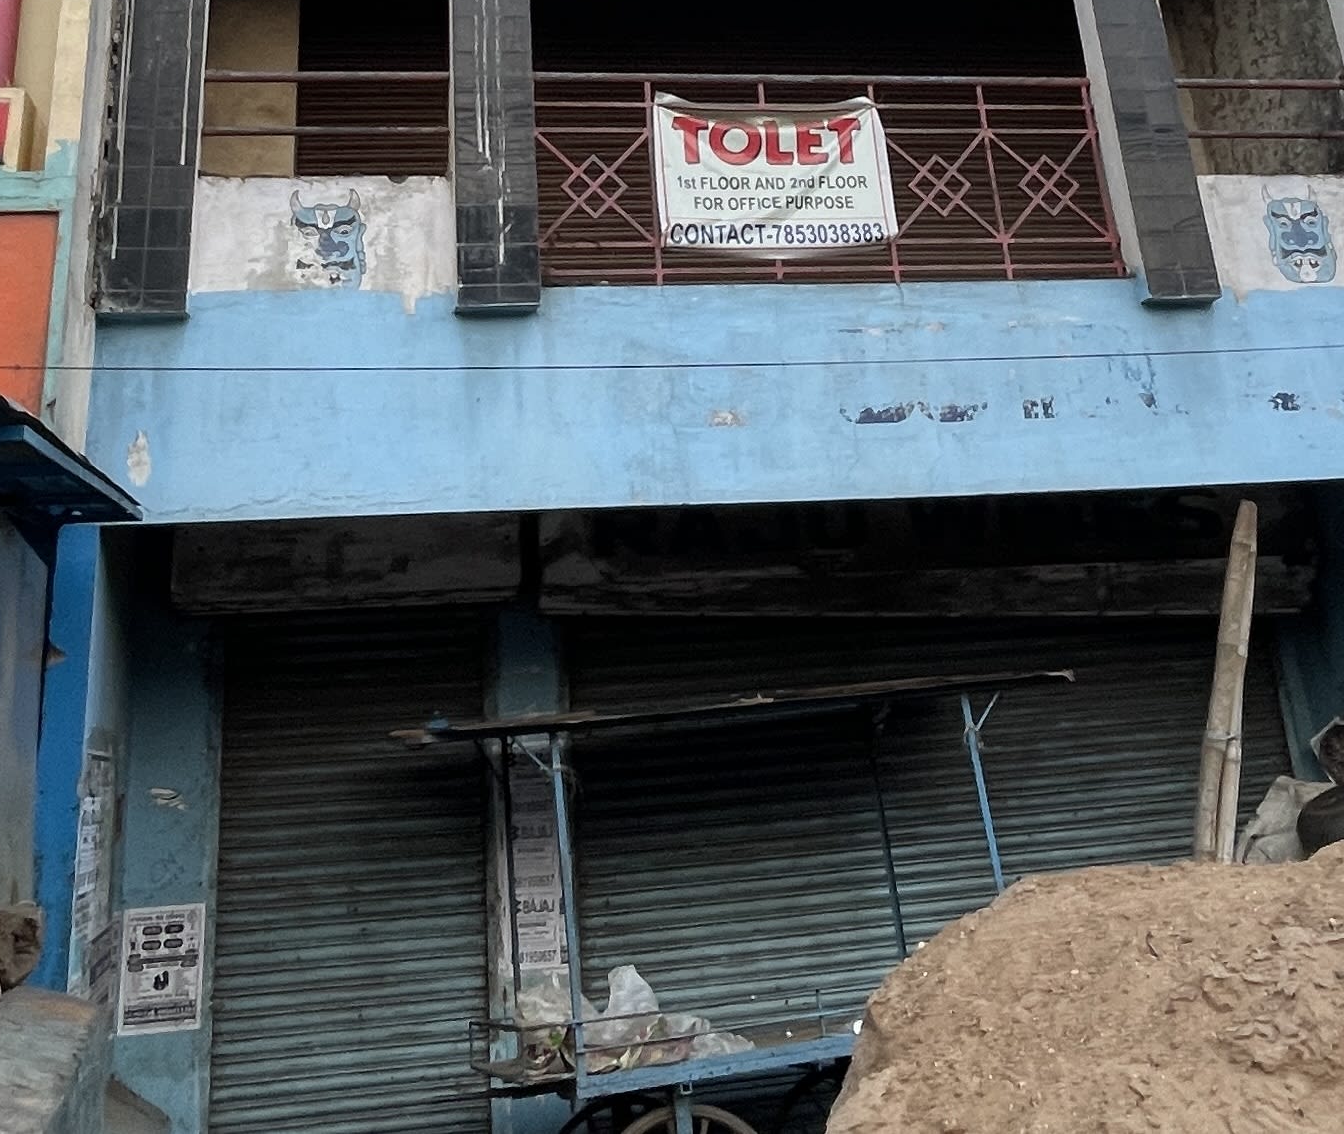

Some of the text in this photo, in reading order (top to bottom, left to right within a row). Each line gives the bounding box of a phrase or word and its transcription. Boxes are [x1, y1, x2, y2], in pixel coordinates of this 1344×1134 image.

[671, 115, 861, 165] TOLET
[676, 175, 868, 190] 1st FLOOR AND 2nd FLOOR
[694, 195, 854, 211] FOR OFFICE PURPOSE
[670, 222, 884, 245] CONTACT-7853038383
[522, 898, 555, 914] BAJAJ
